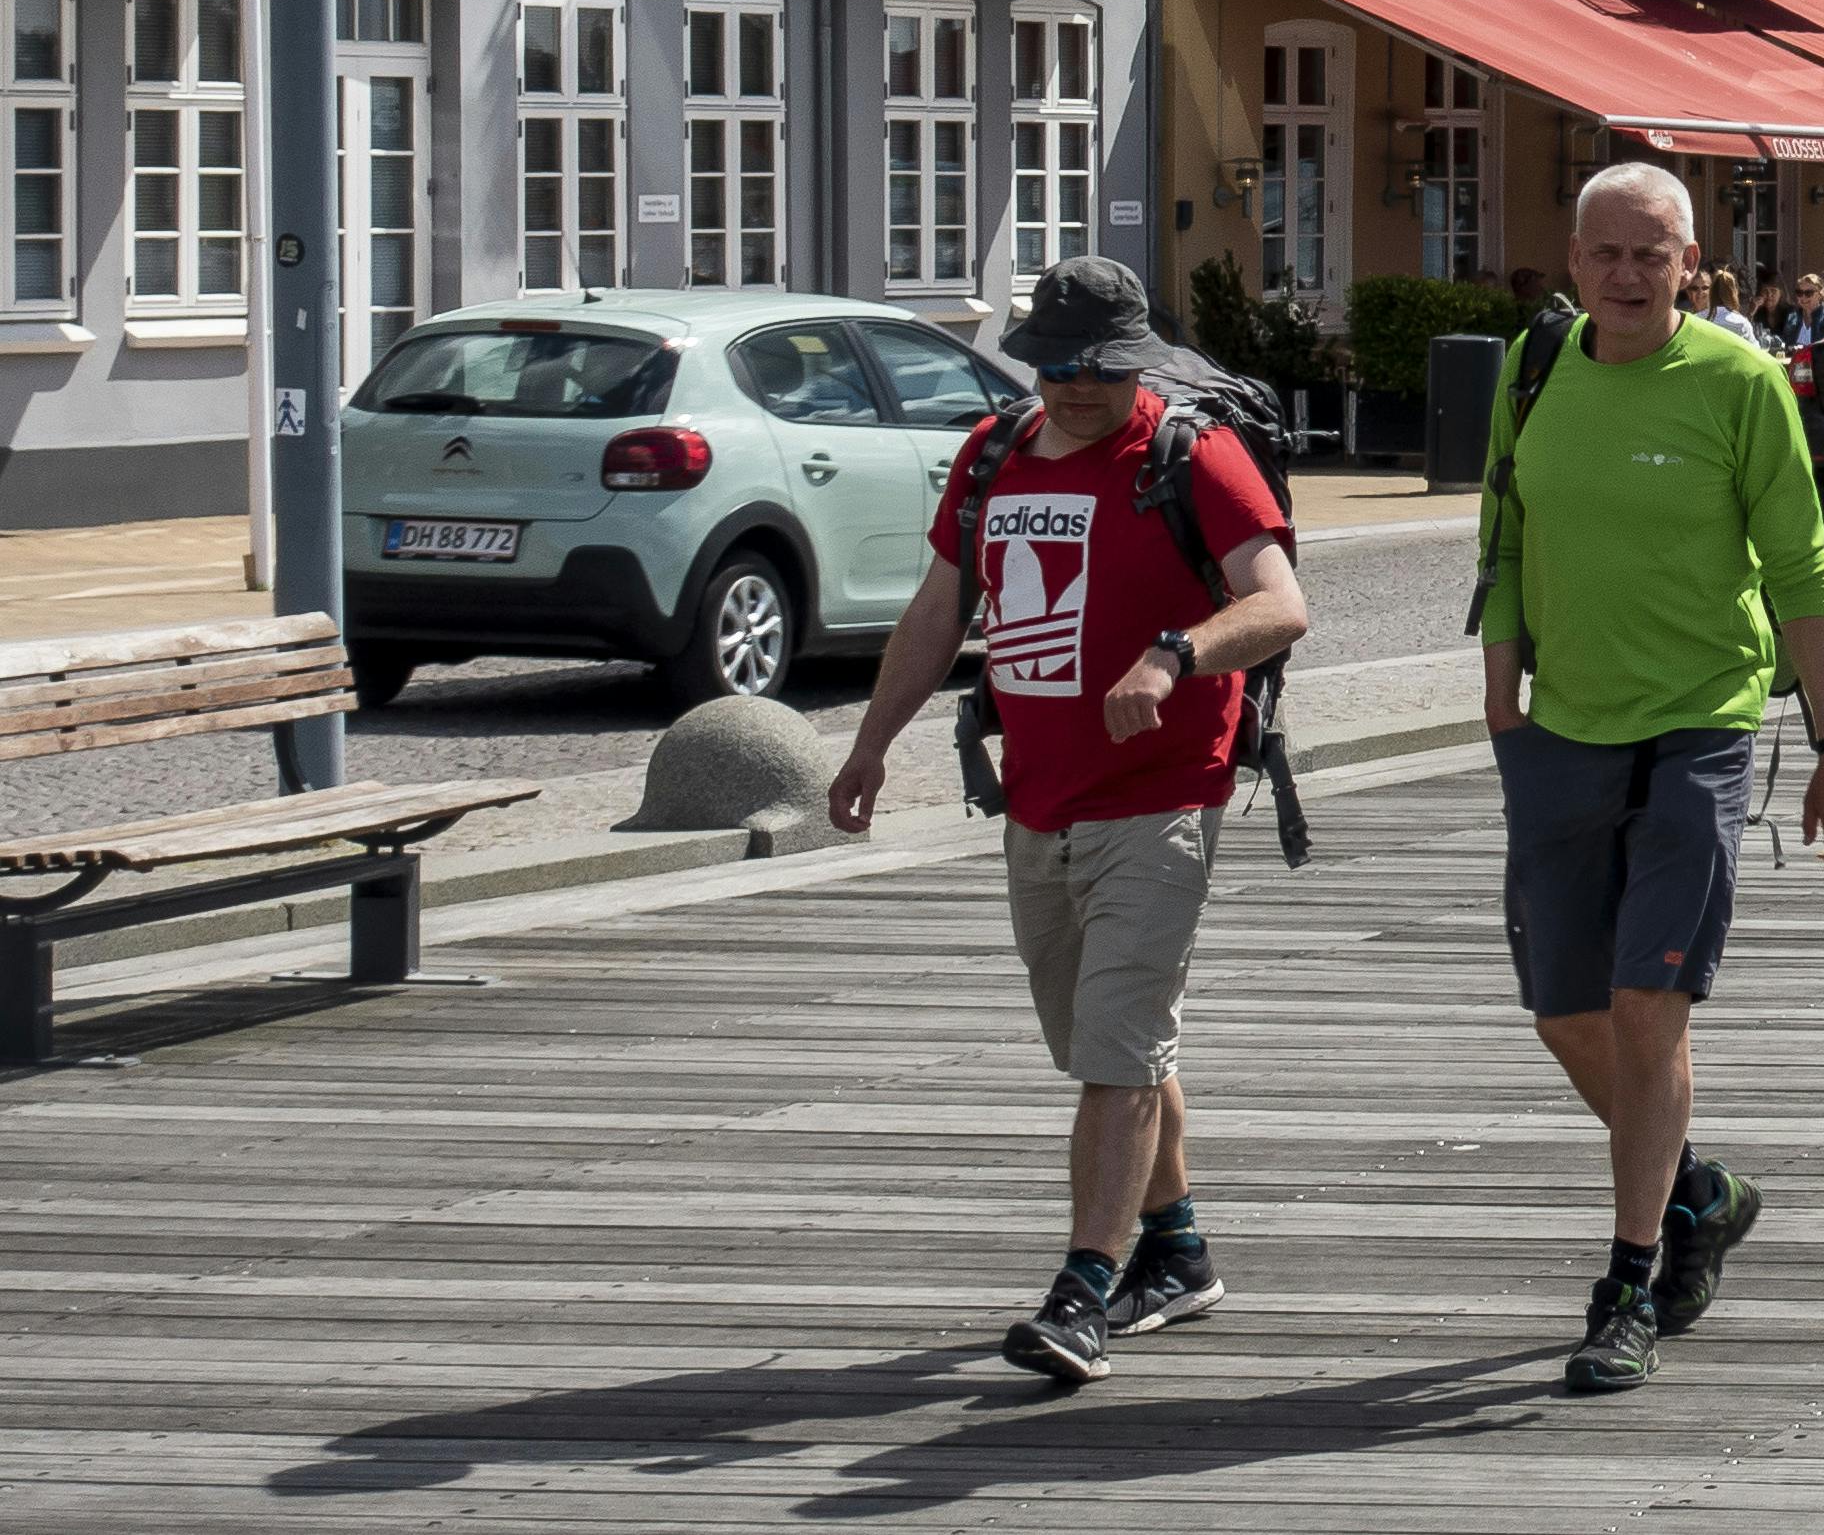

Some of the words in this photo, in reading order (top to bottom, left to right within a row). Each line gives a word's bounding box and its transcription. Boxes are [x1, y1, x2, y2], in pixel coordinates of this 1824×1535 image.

[987, 505, 1086, 537] adidas
[401, 525, 434, 548] DH
[439, 525, 467, 549] 88
[471, 527, 514, 551] 772
